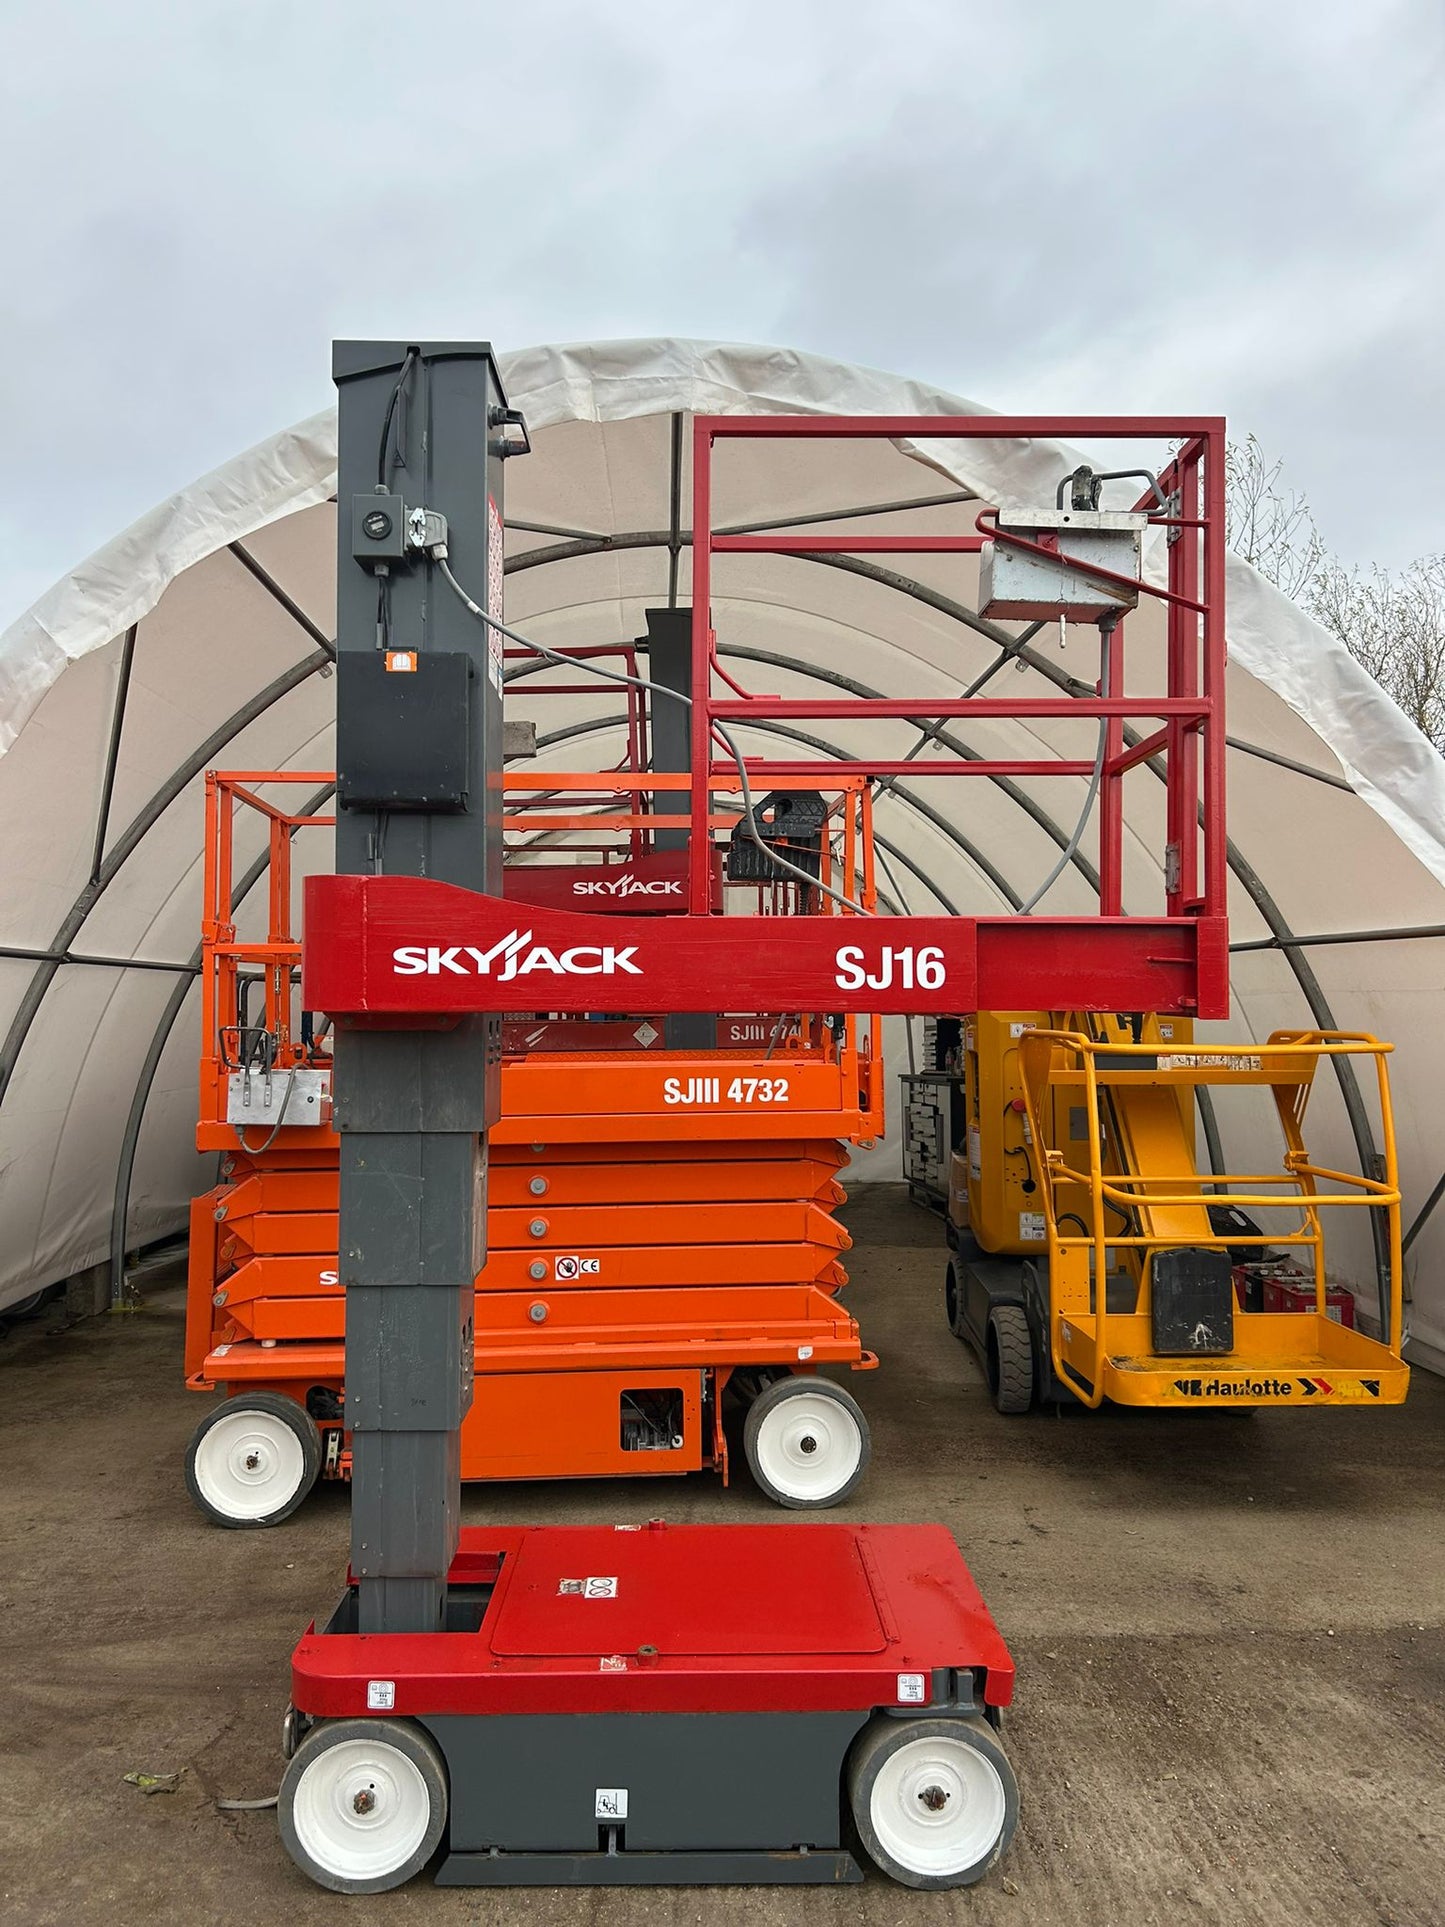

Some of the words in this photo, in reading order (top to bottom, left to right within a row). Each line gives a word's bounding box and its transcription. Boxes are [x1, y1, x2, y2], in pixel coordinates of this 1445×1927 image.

[572, 873, 684, 898] SKYJACK
[392, 928, 645, 982] SKYJACK
[835, 945, 946, 990] SJ16
[730, 1025, 764, 1041] SJIII
[663, 1077, 720, 1104] SJIII
[727, 1077, 789, 1103] 4732
[1206, 1379, 1292, 1397] Haulotte
